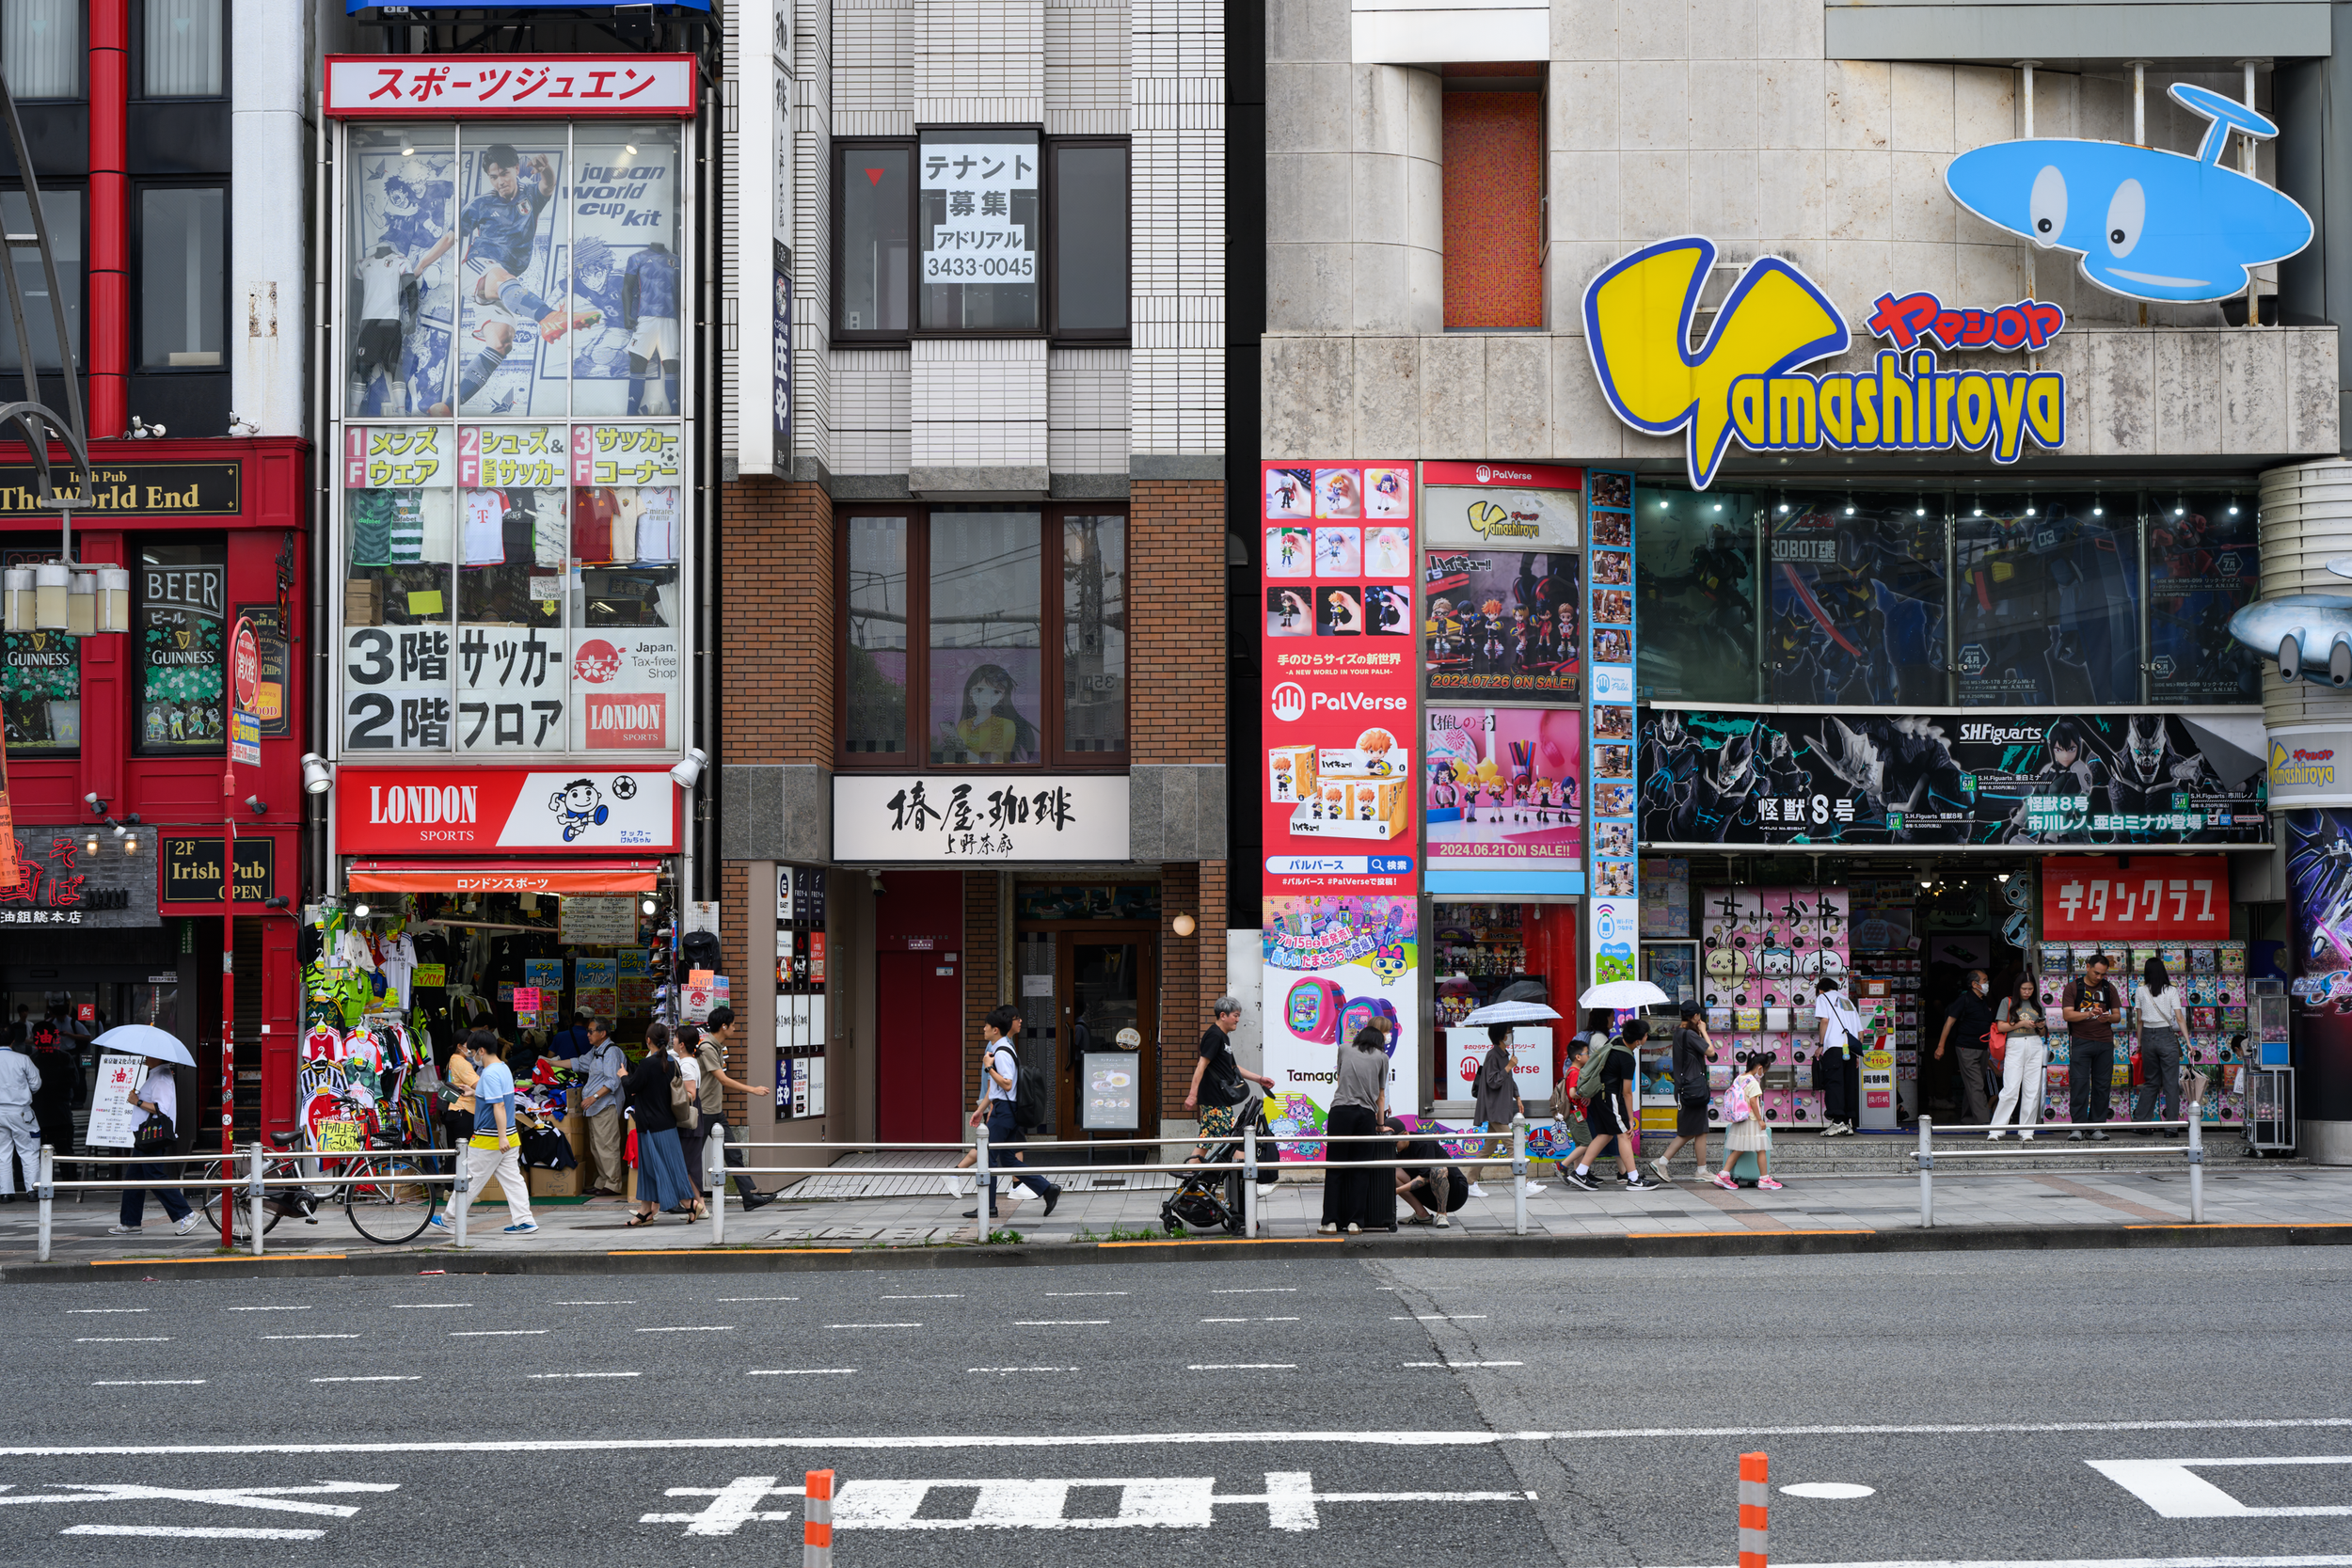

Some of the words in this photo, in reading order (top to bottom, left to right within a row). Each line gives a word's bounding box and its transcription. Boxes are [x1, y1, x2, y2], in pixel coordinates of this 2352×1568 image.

[368, 67, 656, 102] スポーツジュエン
[579, 163, 666, 183] japan
[926, 154, 1033, 181] テナント
[949, 190, 1008, 217] 募集
[577, 202, 626, 219] cup
[621, 209, 662, 227] kit
[937, 231, 1024, 250] アドリアル
[928, 257, 1034, 277] 3433-0045
[1866, 291, 2066, 354] ヤマシロヤ
[1583, 234, 2066, 491] Yamashiroya
[369, 427, 438, 456] メンズ
[596, 428, 678, 453] サッカー
[103, 471, 127, 483] Pub
[369, 458, 439, 486] ウェア
[499, 458, 564, 486] サッカー
[595, 459, 678, 484] コーナー
[1492, 469, 1533, 482] PalVerse
[146, 483, 199, 509] End
[148, 572, 218, 609] BEER
[151, 610, 187, 625] ビール
[7, 651, 71, 666] GUINNESS
[151, 649, 215, 665] GUINNESS
[348, 629, 450, 685] 3階
[459, 629, 563, 688] サッカー
[635, 642, 677, 655] Japan.
[237, 651, 256, 684] 消火栓
[631, 656, 677, 667] Tax-free
[1277, 653, 1402, 666] 手のひらサイズの新世界
[1964, 655, 1979, 664] 4月
[648, 668, 677, 680] Shop
[1430, 673, 1510, 690] 2024.07.26
[1512, 674, 1533, 689] ON
[1535, 674, 1576, 690] SALE!!
[1311, 691, 1407, 711] PalVerse
[348, 693, 450, 748] 2階
[459, 699, 564, 748] フロア
[591, 705, 660, 730] LONDON
[369, 785, 478, 824] LONDON
[1757, 794, 1856, 825] 怪獣8号
[2026, 795, 2090, 814] 怪獣8号
[420, 830, 475, 841] SPORTS
[175, 842, 195, 856] 2F
[1439, 844, 1506, 857] 2024.06.21
[1507, 844, 1528, 857] ON
[1530, 844, 1570, 857] SALE!!
[172, 863, 220, 879] Irish
[1289, 860, 1344, 871] パルバース
[1387, 860, 1407, 871] 検索
[456, 878, 549, 889] ロンドンスポーツ
[1281, 877, 1325, 887] #パルバース
[1327, 877, 1398, 887] #PalVerseで投稿!
[2058, 879, 2216, 922] キタンクラブ
[1713, 896, 1841, 931] ちいかわ
[1863, 1075, 1890, 1084] 両替機
